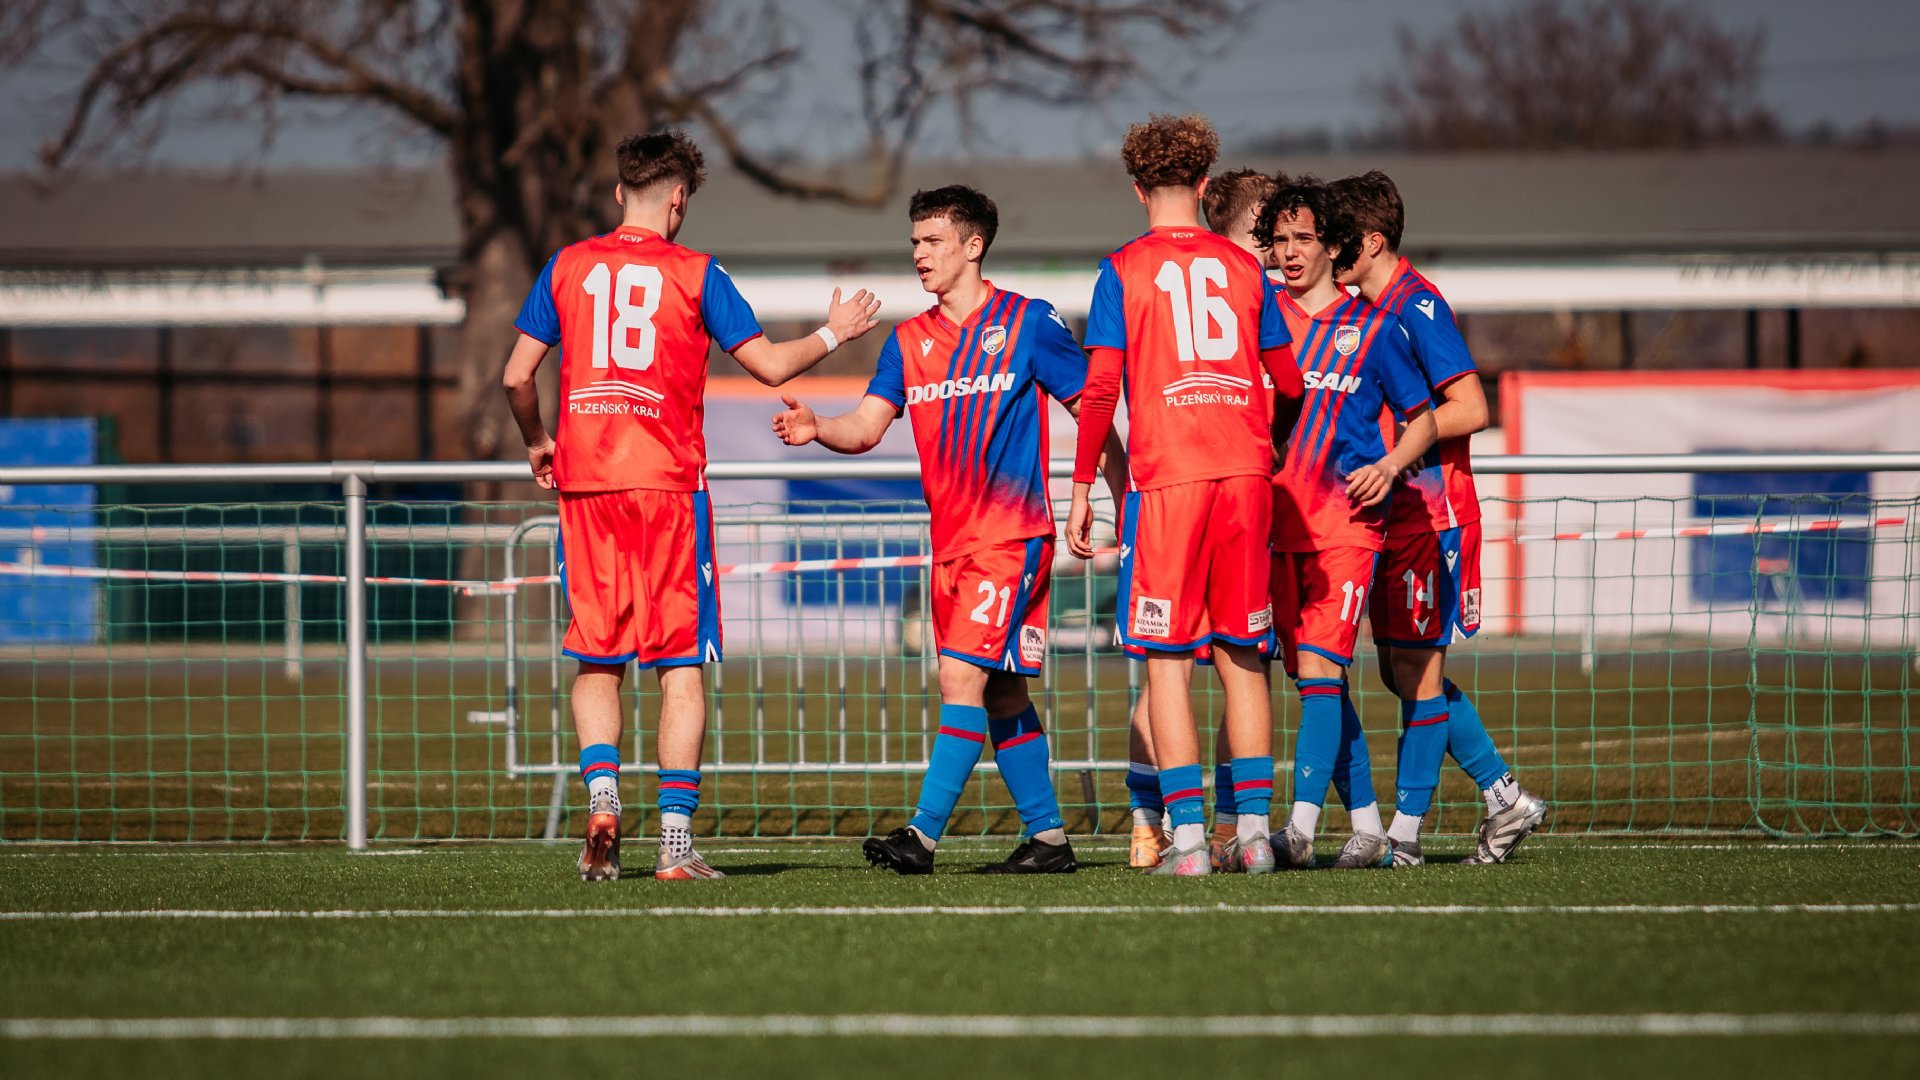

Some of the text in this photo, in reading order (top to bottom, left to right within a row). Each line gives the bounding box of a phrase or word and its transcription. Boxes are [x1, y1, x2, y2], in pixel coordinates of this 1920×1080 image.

[619, 233, 643, 243] FCVP
[581, 262, 664, 371] 18
[1154, 257, 1238, 361] 16
[569, 400, 661, 419] PLZEŇSKÝ KRAJ
[906, 372, 1016, 405] DOOSAN
[1166, 391, 1220, 407] PLZEŇSKÝ
[970, 580, 1011, 629] 21
[1340, 580, 1365, 626] 11
[1401, 568, 1434, 610] 14
